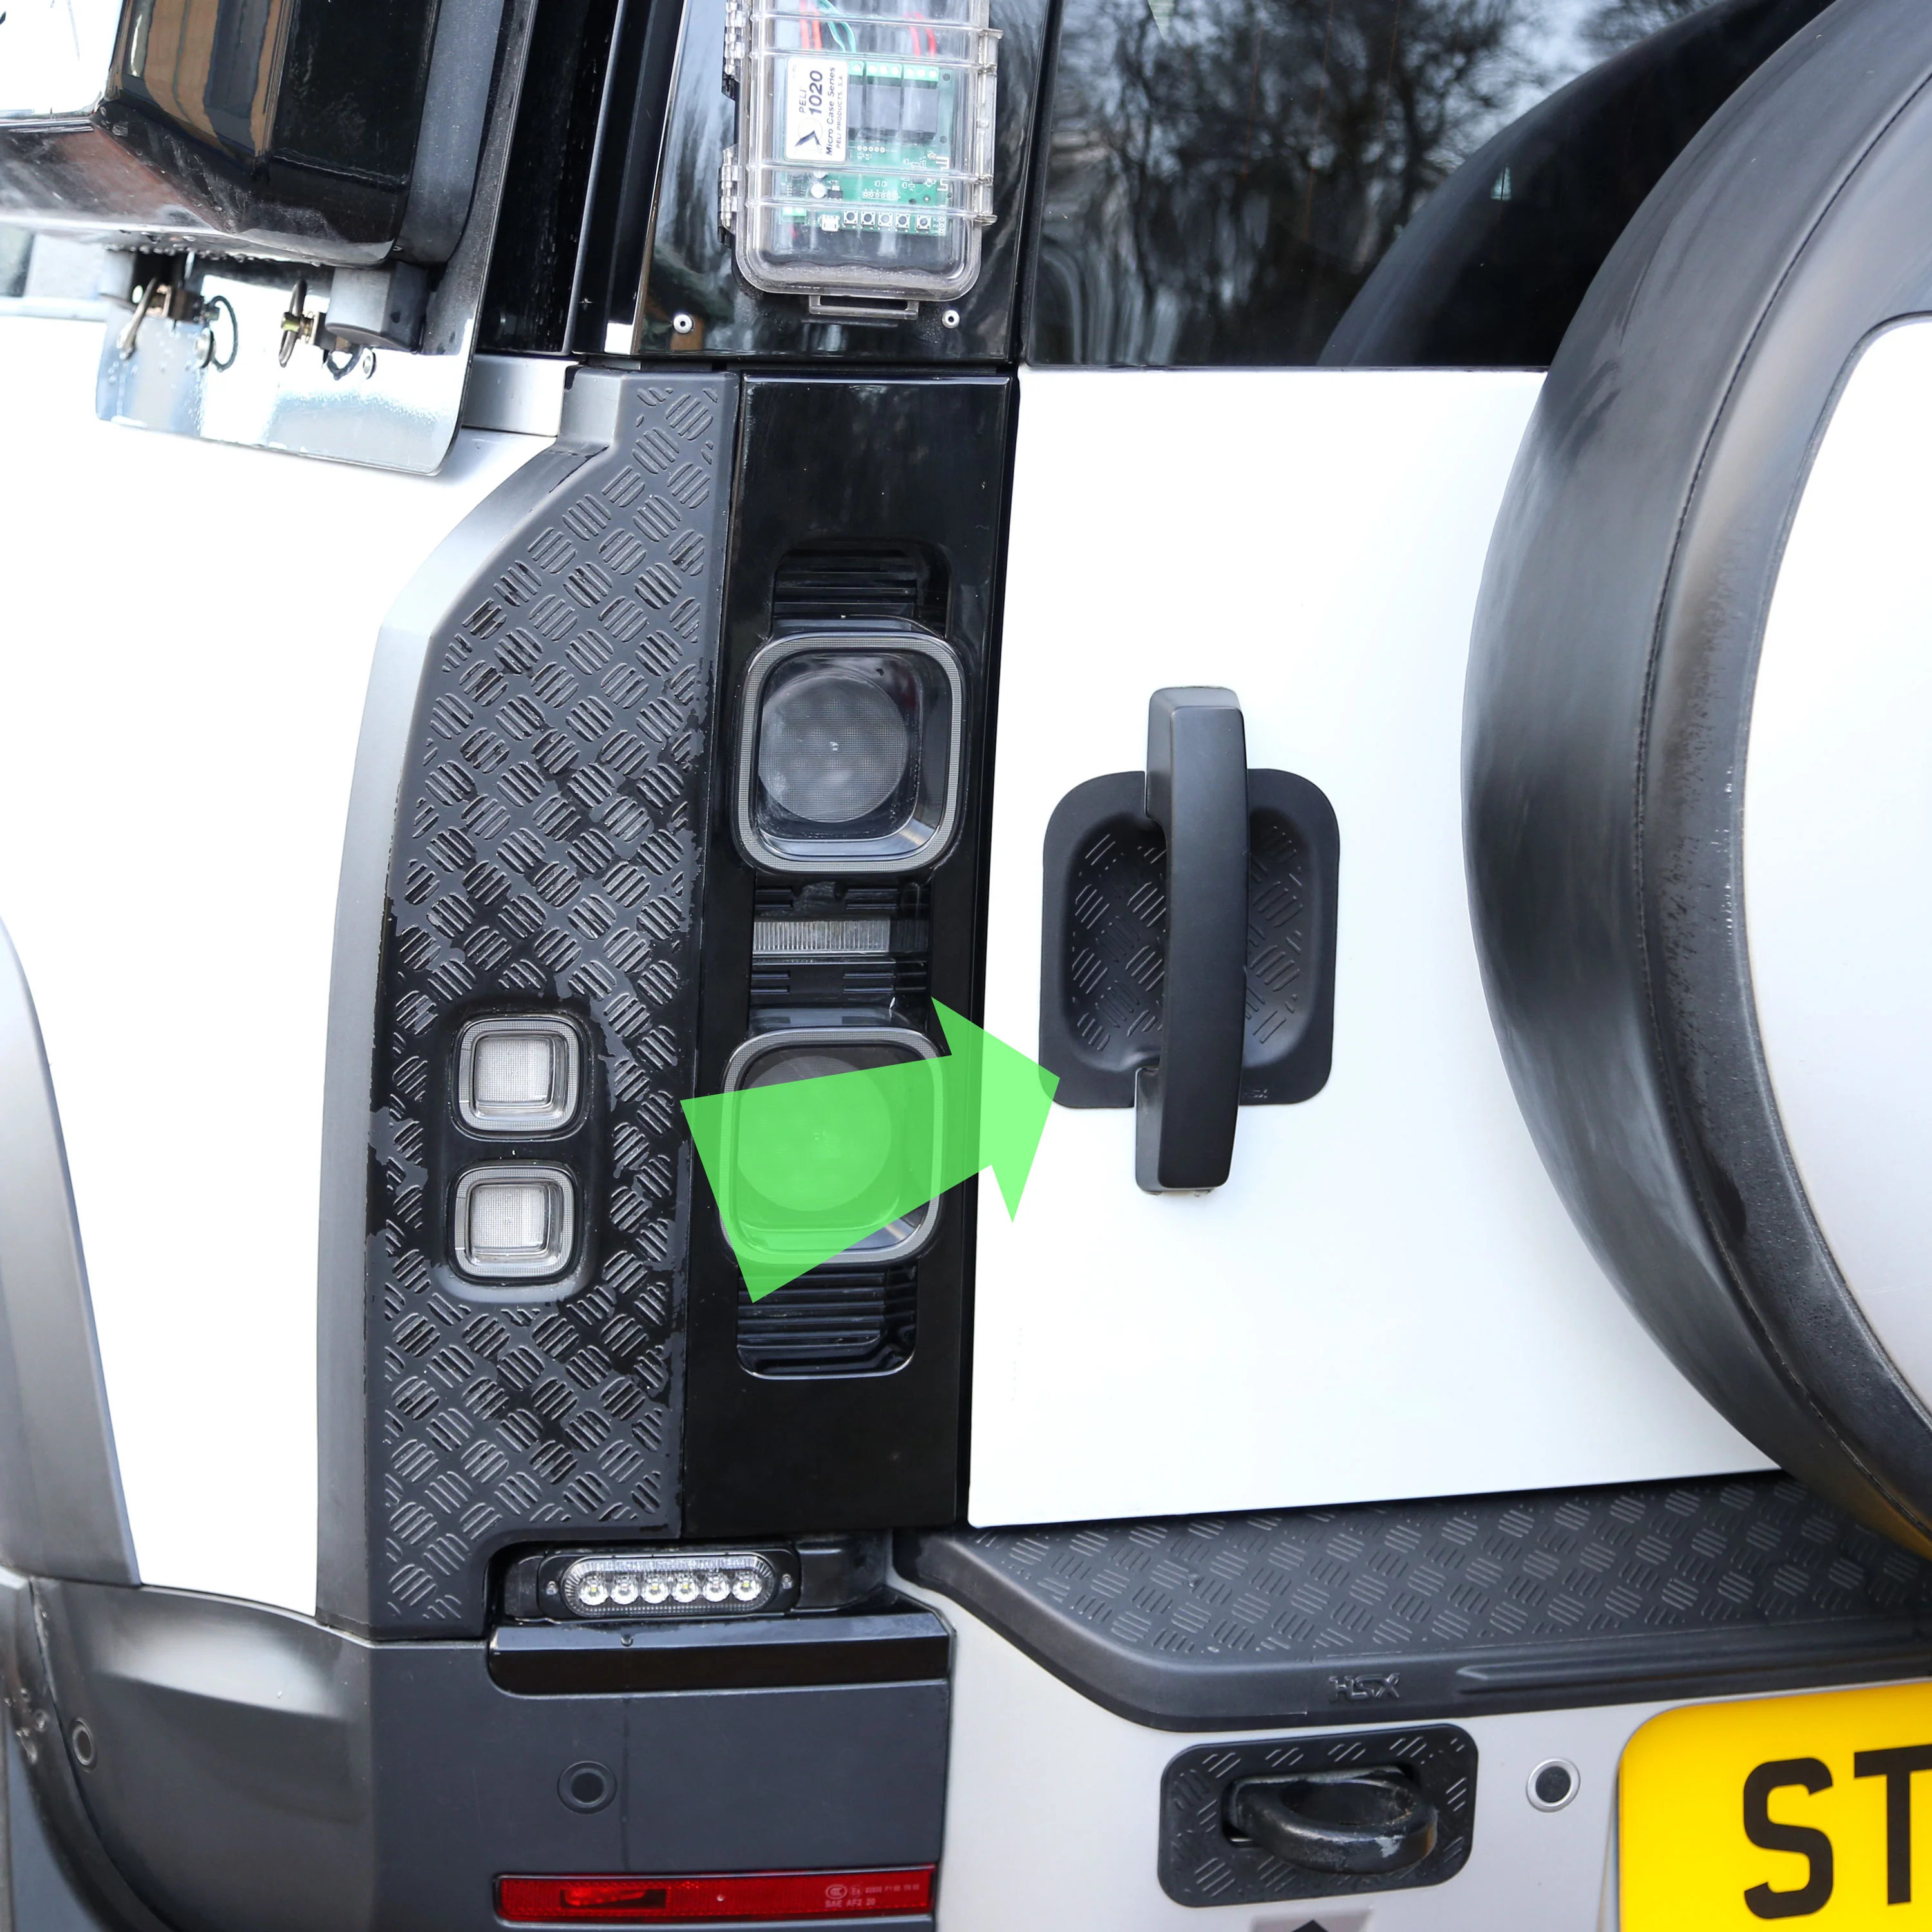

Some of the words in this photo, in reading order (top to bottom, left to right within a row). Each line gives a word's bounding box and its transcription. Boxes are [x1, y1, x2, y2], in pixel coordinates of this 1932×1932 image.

[809, 70, 823, 115] 1020
[1743, 1743, 1932, 1921] ST
[825, 1899, 842, 1908] SAE
